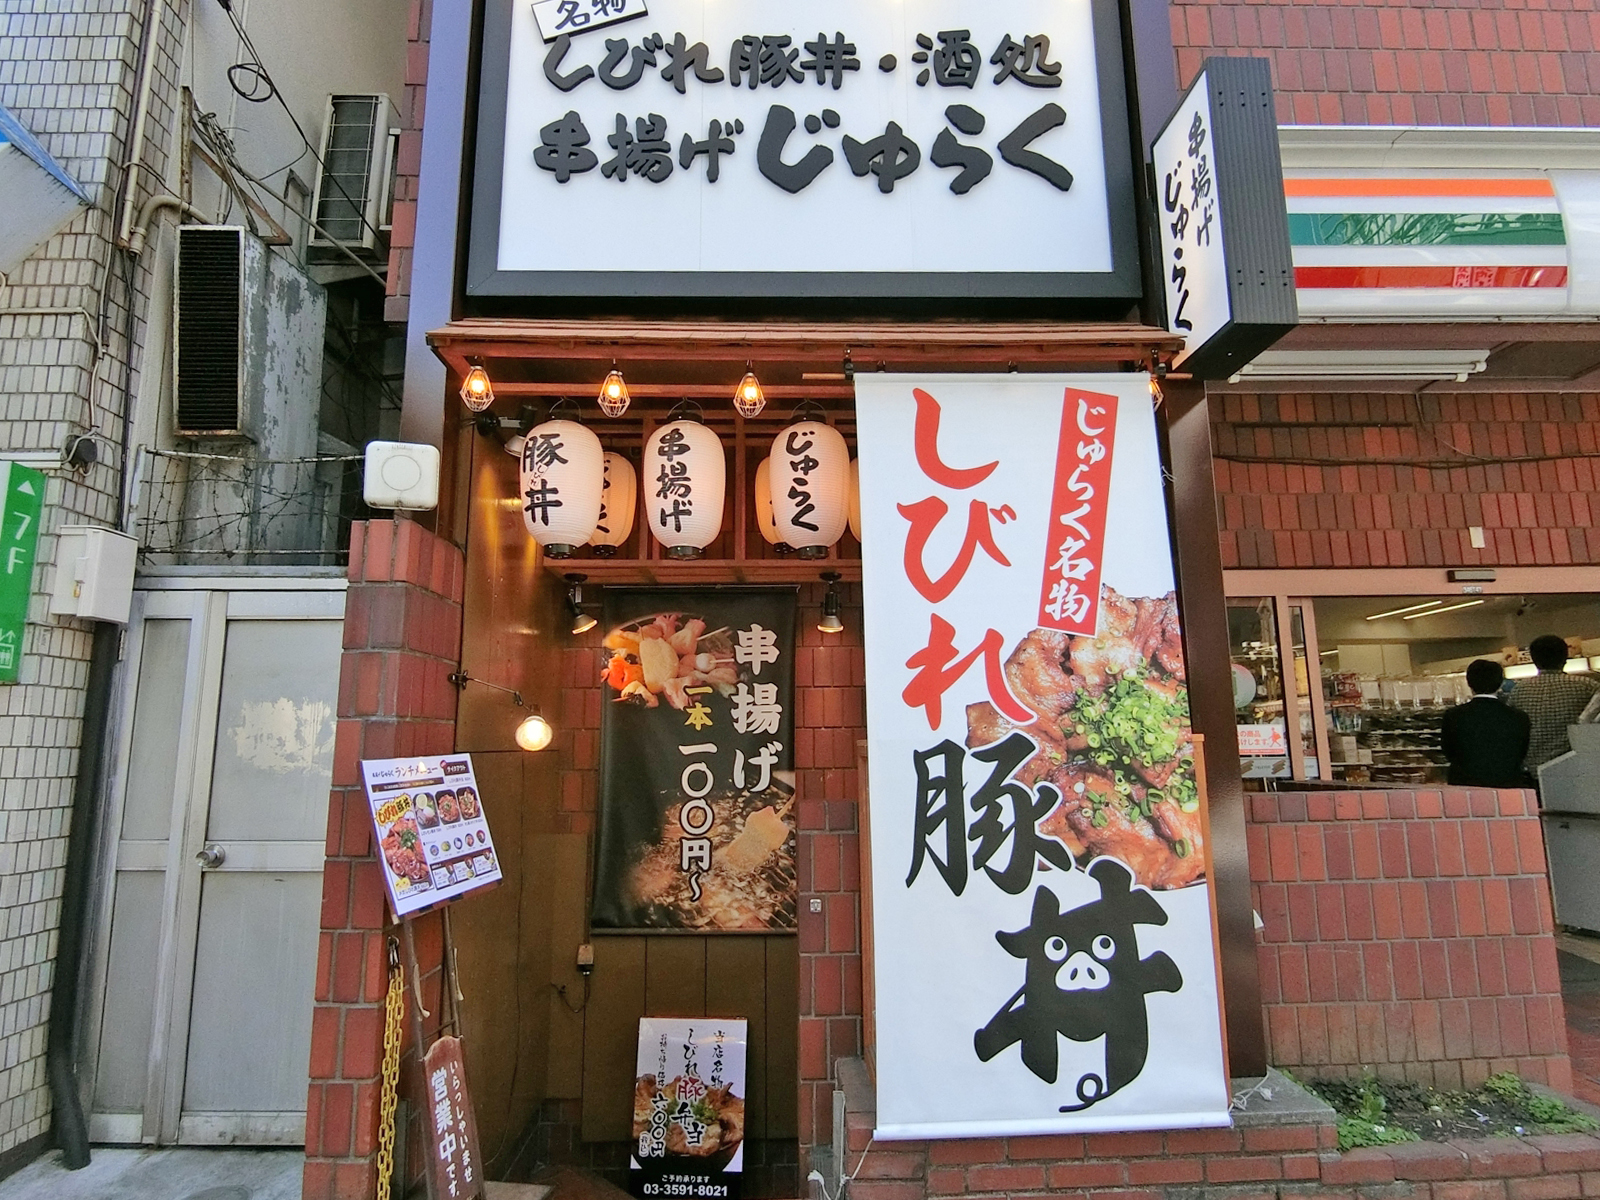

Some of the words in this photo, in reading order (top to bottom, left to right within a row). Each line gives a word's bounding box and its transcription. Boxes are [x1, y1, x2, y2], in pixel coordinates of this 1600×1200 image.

[533, 103, 1074, 194] 串揚げじゅらく
[1188, 111, 1214, 247] 串揚げ
[1164, 161, 1192, 331] じゅらく
[656, 428, 692, 533] 串揚げ
[786, 431, 820, 532] じゅらく
[1044, 398, 1107, 624] じゅらく名物
[683, 685, 714, 731] 一本
[730, 624, 783, 793] 串揚げ
[671, 1028, 705, 1146] しびれ豚弁当
[710, 1030, 726, 1089] 当店名物
[449, 1060, 473, 1183] いらっしゃいませ
[643, 1183, 728, 1197] 03-3591-8021
[662, 1174, 711, 1184] ご予約承ります
